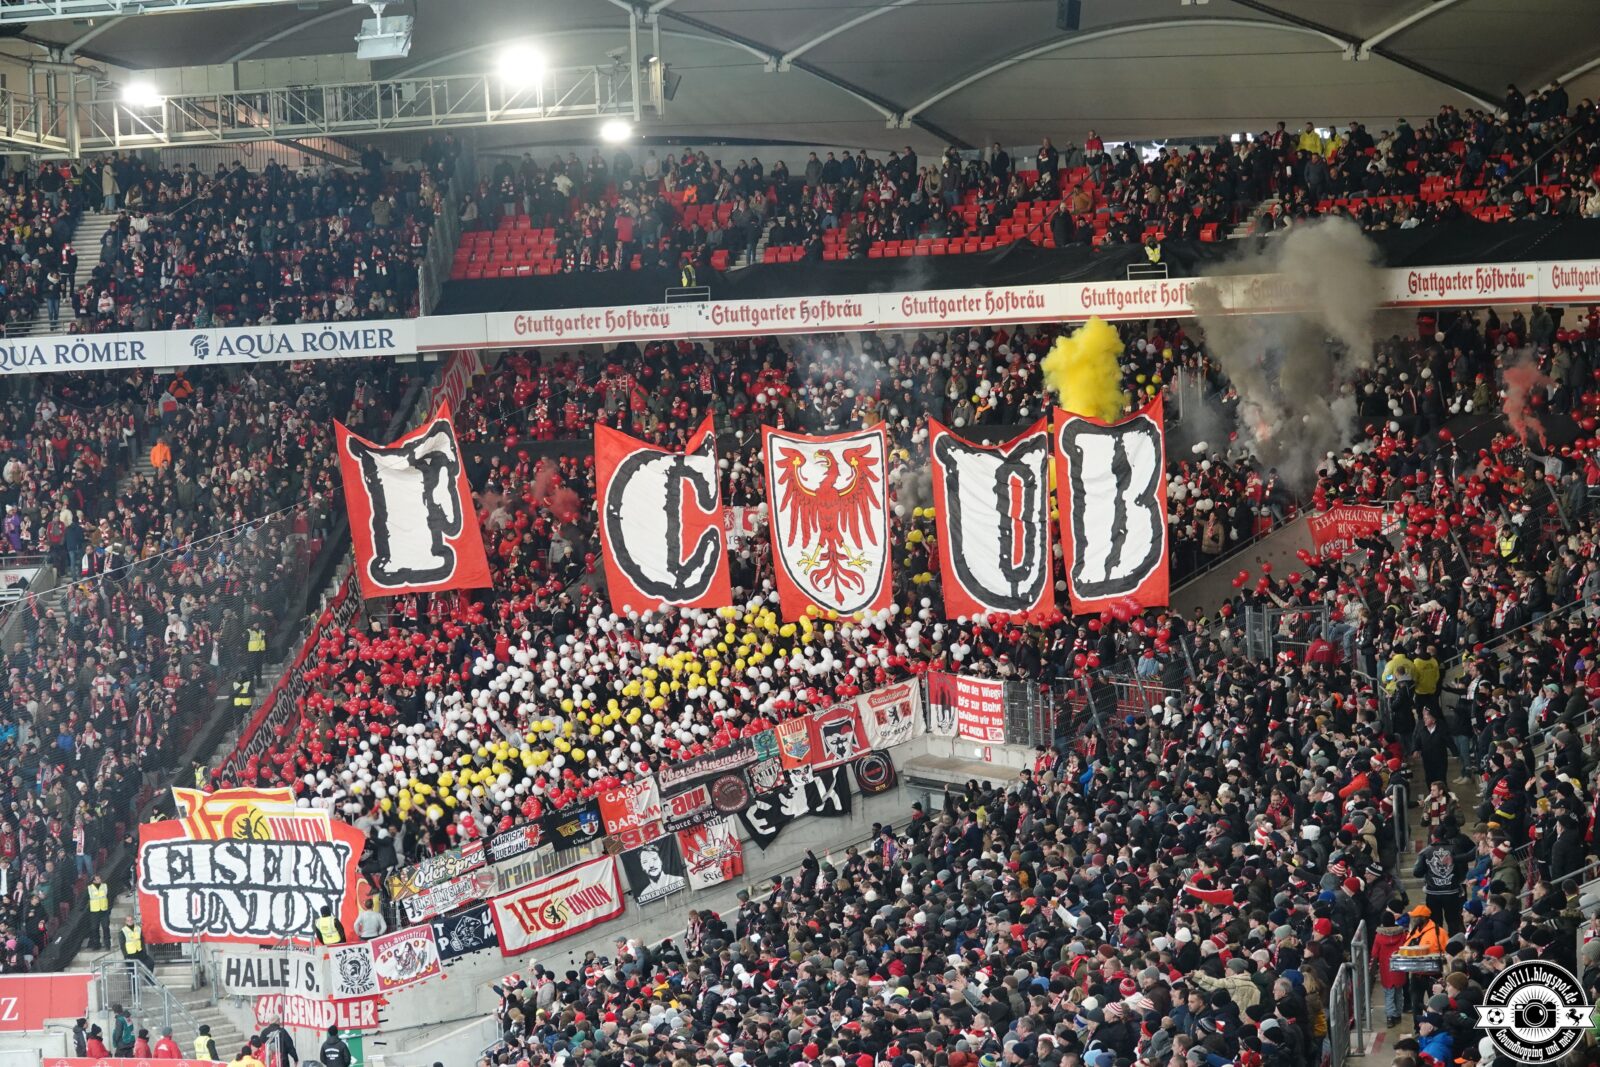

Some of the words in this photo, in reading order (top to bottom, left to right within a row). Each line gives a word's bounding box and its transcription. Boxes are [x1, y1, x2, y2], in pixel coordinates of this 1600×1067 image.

[1408, 271, 1473, 296] Stuttgarter
[1476, 267, 1525, 294] Hofbräu
[1552, 265, 1600, 292] Stuttgart
[902, 296, 981, 319] Stuttgarter
[985, 290, 1045, 315] Hofbräu
[1081, 286, 1157, 310] Stuttgarter
[514, 313, 601, 336] Stuttgarter
[712, 304, 796, 327] Stuttgarter
[800, 300, 862, 323] Hofbräu
[55, 338, 147, 364] RÖMER
[217, 332, 295, 359] AQUA
[302, 326, 395, 352] RÖMER
[1059, 414, 1165, 601] B
[660, 746, 758, 783] Oberschöneweide
[605, 781, 650, 803] GARDE
[145, 839, 350, 893] EISERN
[414, 865, 447, 888] Oder
[445, 850, 487, 877] Spree
[565, 883, 611, 915] UNION
[225, 957, 290, 987] HALLE
[304, 961, 320, 993] S.
[0, 997, 19, 1021] Z
[257, 995, 376, 1027] SACHSENADLER
